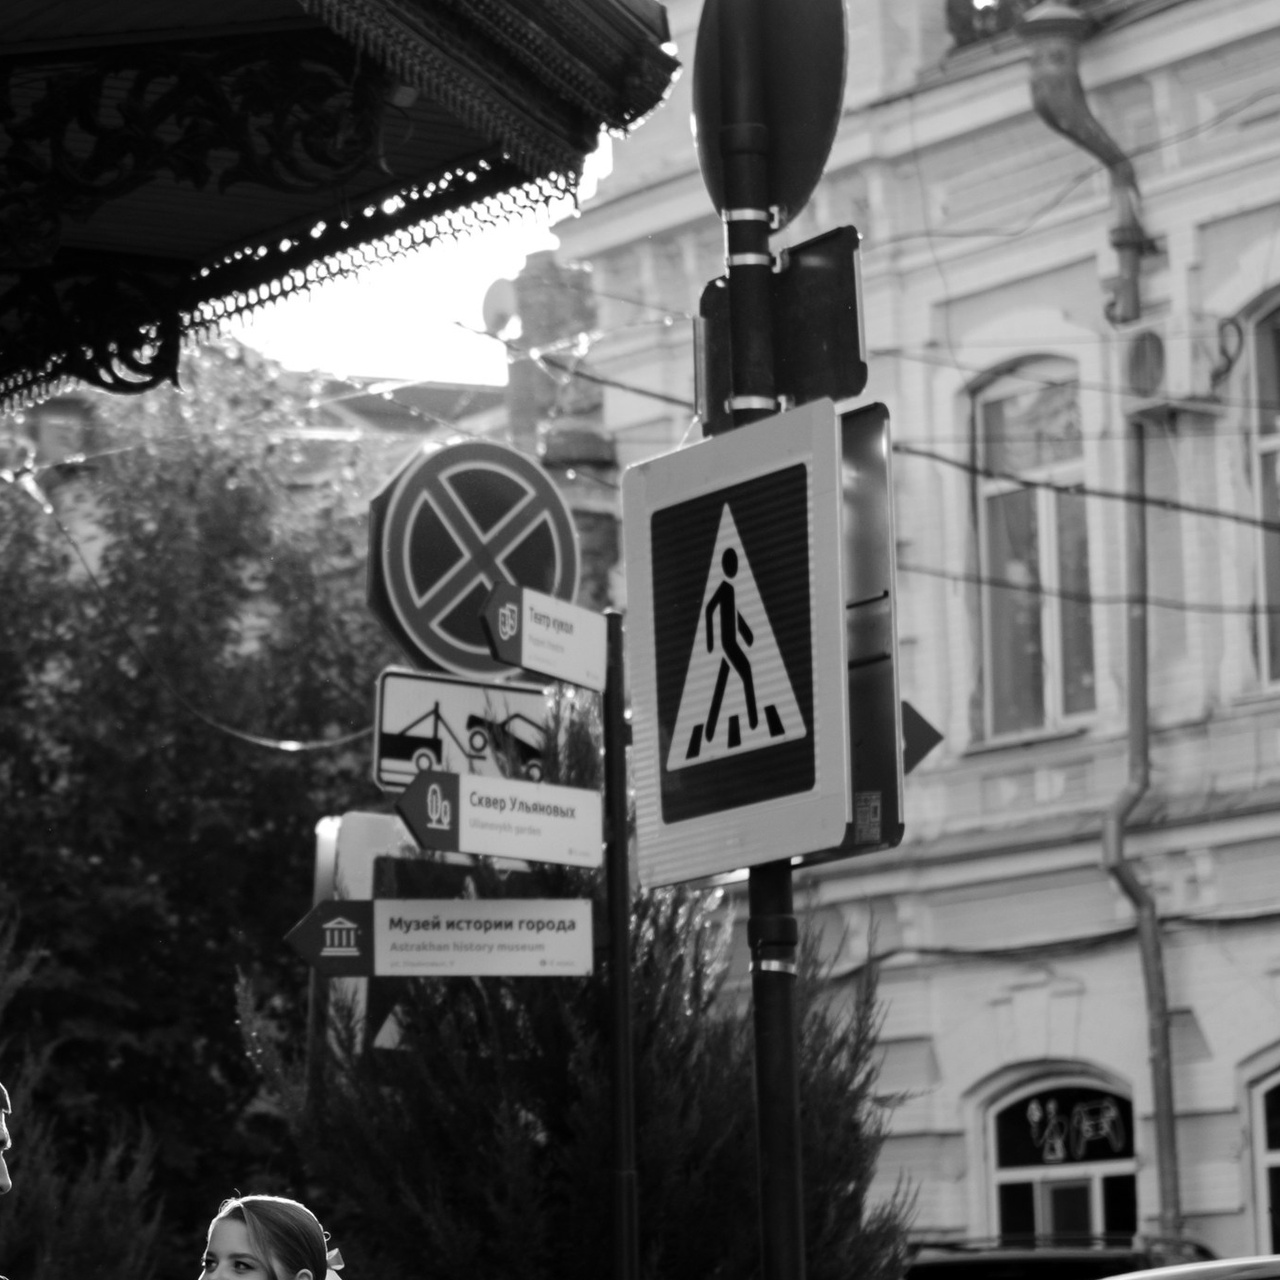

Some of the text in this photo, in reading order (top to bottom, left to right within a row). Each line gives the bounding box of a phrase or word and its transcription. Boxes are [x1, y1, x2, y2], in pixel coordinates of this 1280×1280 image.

[469, 791, 576, 819] Сквер Ульяновых
[389, 914, 577, 934] Музей истории города
[389, 941, 545, 954] Astrakhan history museum
